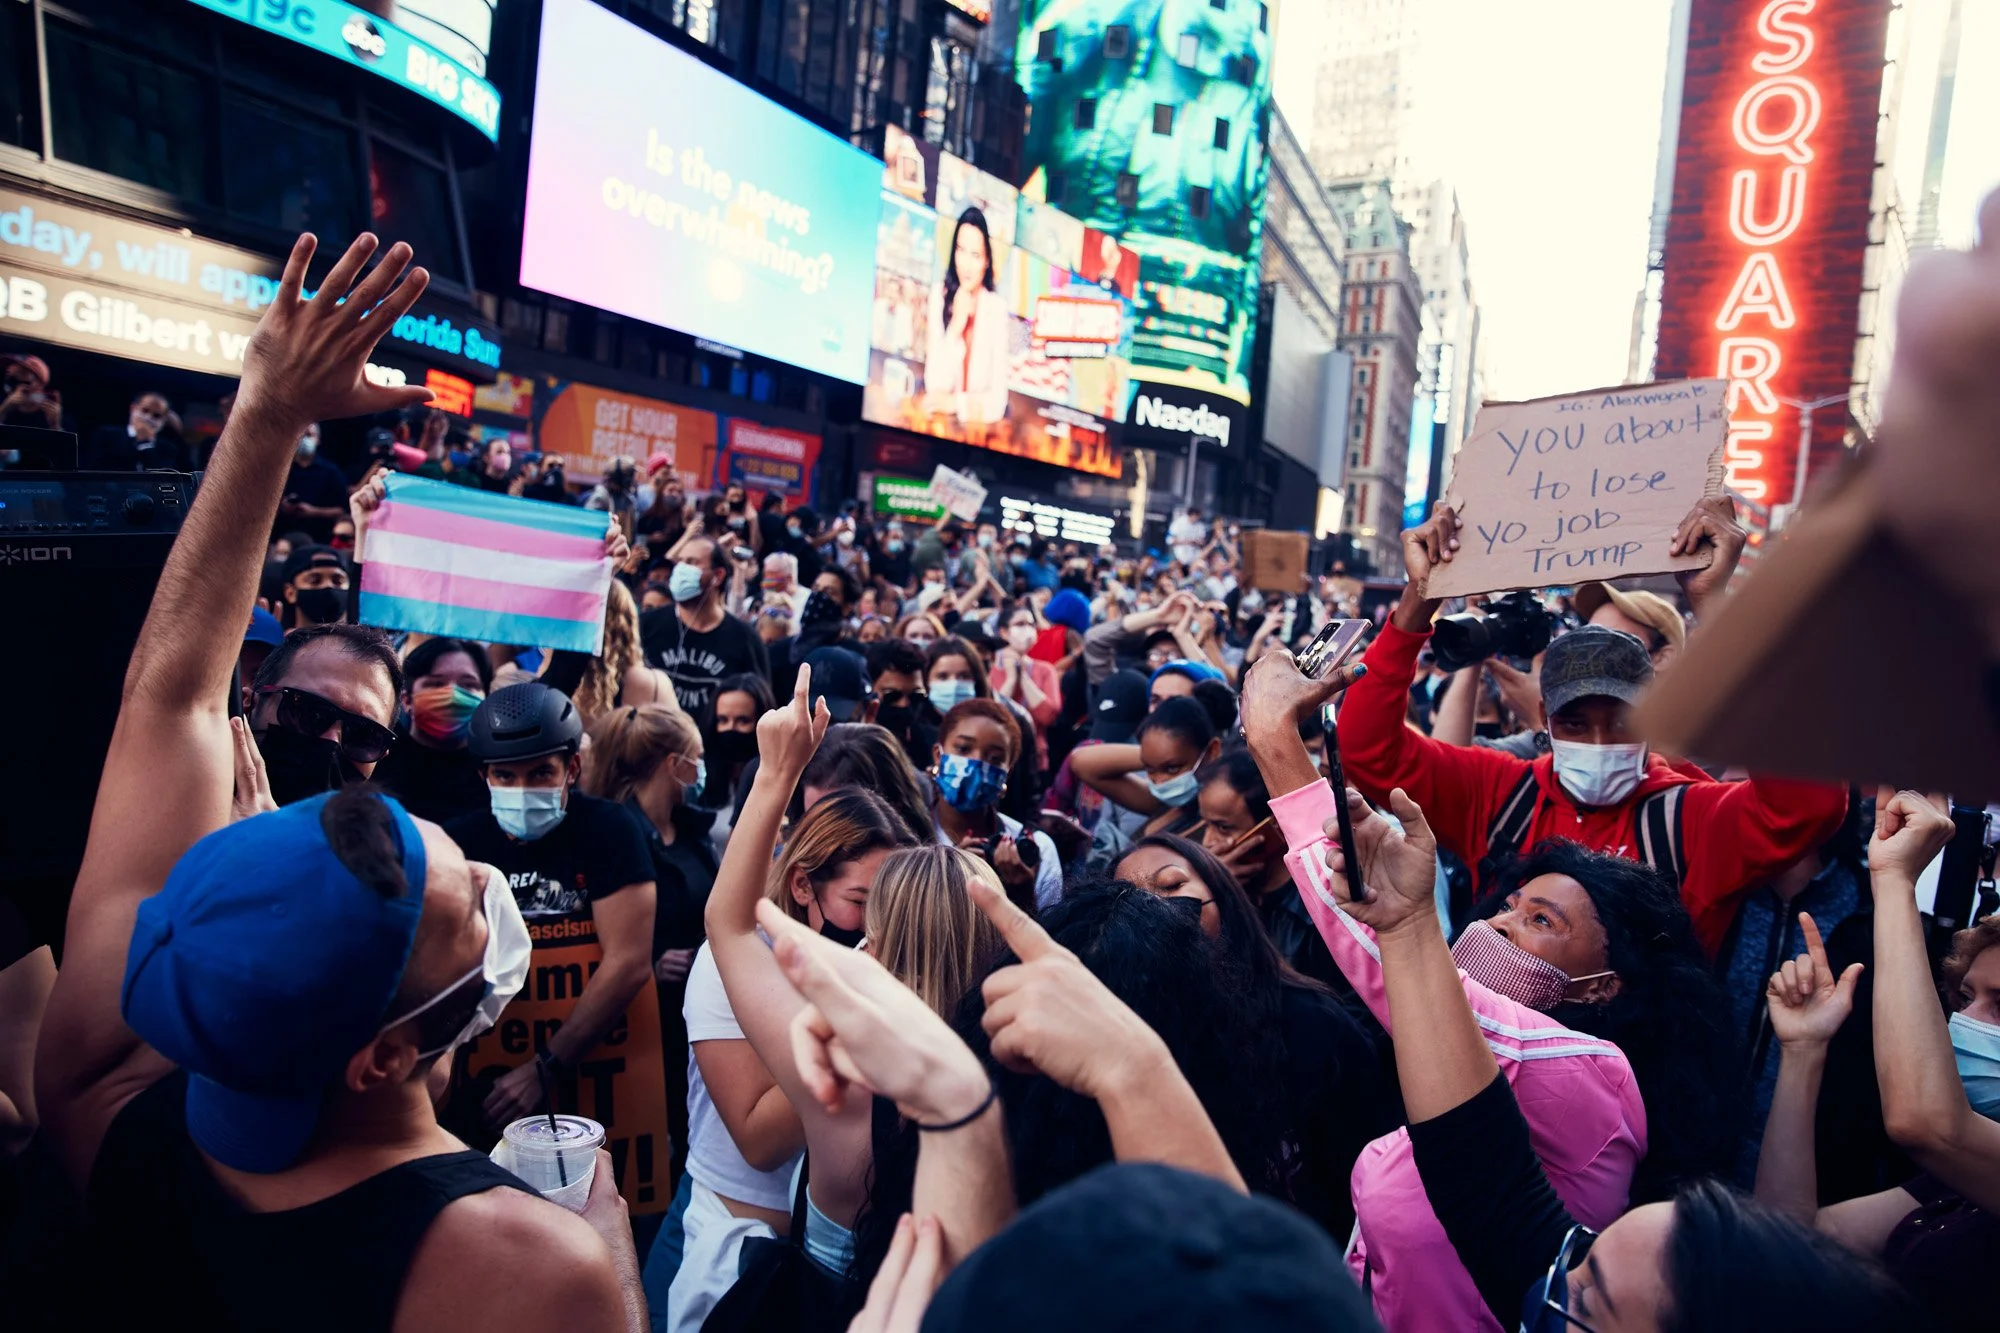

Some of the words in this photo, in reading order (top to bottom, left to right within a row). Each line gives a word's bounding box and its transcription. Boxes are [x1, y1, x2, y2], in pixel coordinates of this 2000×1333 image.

[406, 44, 459, 101] BIG
[460, 77, 500, 132] SKY
[645, 126, 674, 177] Is
[680, 147, 732, 201] the
[736, 181, 811, 236] news
[116, 240, 190, 285] will
[1713, 0, 1821, 500] SQUARE
[60, 290, 213, 355] Gilbert
[1136, 395, 1231, 448] Nasdaq
[1604, 403, 1712, 445] about
[1528, 470, 1571, 501] to
[1591, 468, 1674, 497] lose
[1541, 508, 1621, 545] job
[1524, 540, 1643, 574] Trump
[660, 648, 727, 676] MALIBU
